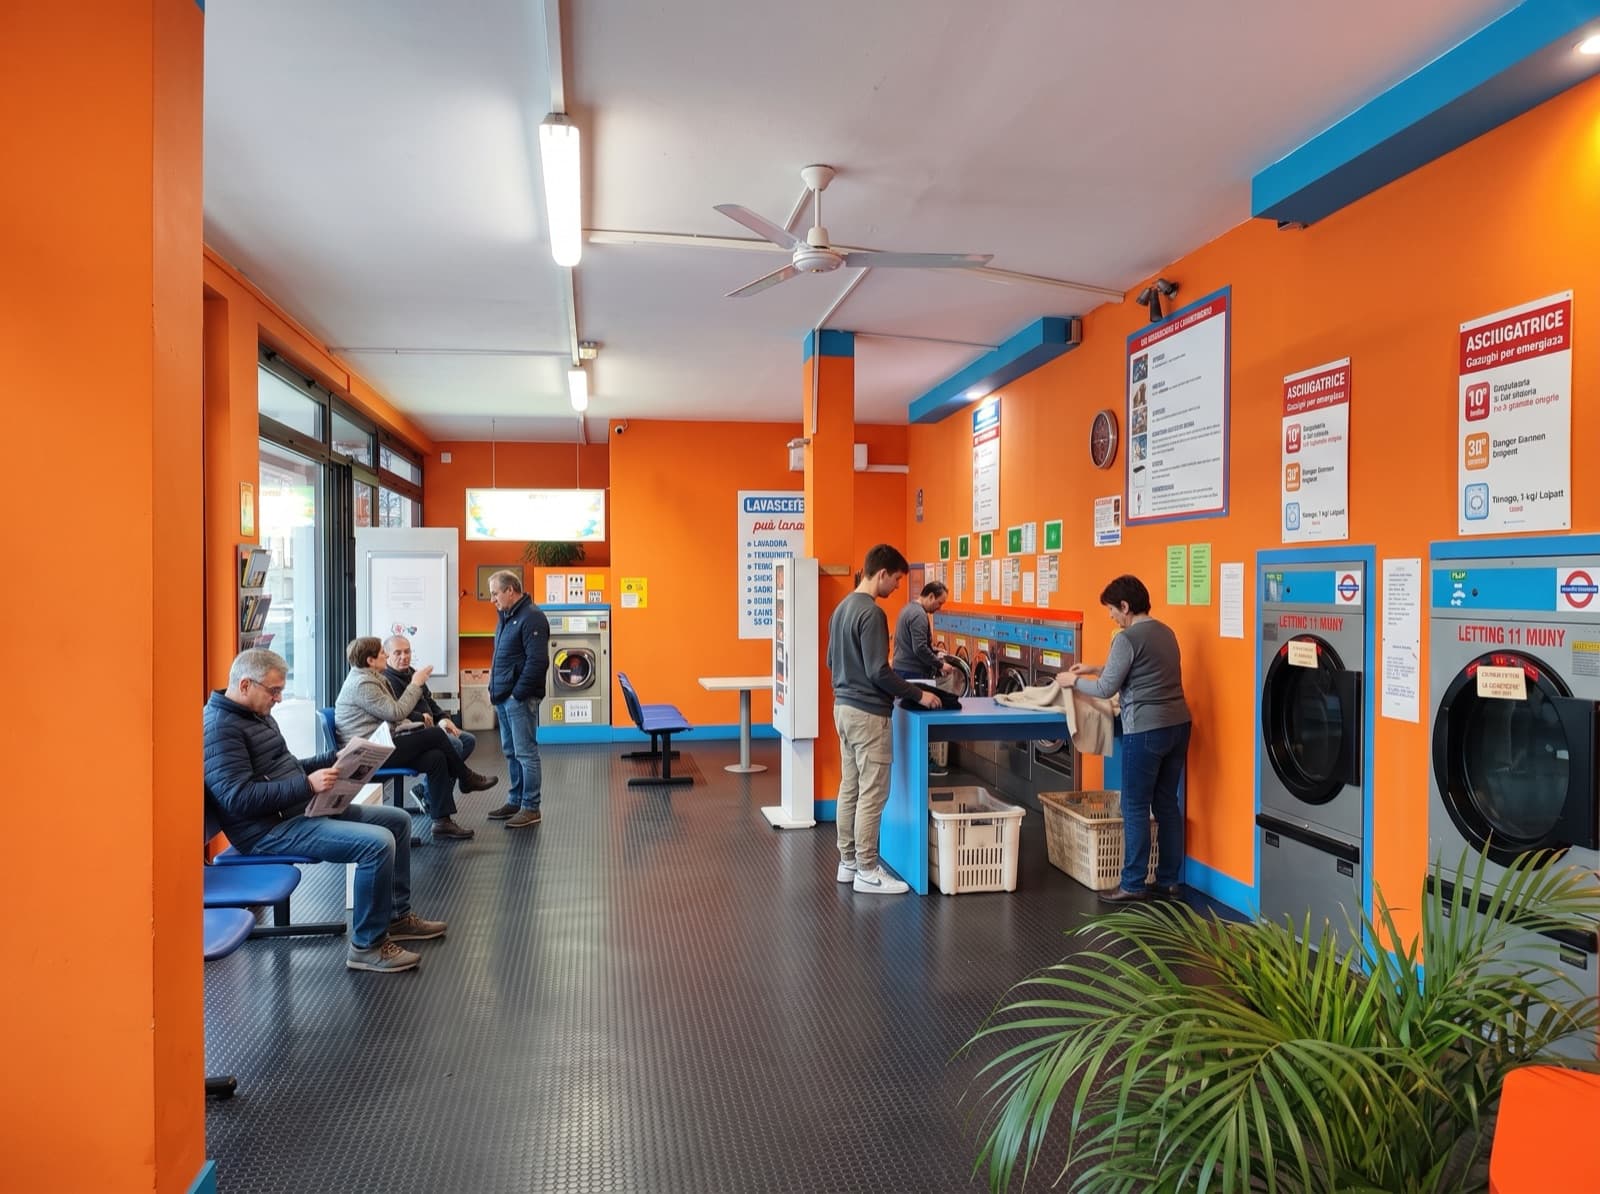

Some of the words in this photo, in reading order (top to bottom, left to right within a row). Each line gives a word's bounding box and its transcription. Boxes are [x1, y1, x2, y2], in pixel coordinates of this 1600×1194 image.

[1466, 309, 1564, 353] ASCIUGATRICE
[1500, 348, 1514, 361] per
[1287, 372, 1345, 400] ASCIUGATRICE
[1458, 625, 1505, 644] LETTING
[1508, 627, 1521, 645] 11
[1526, 628, 1565, 647] MUNY
